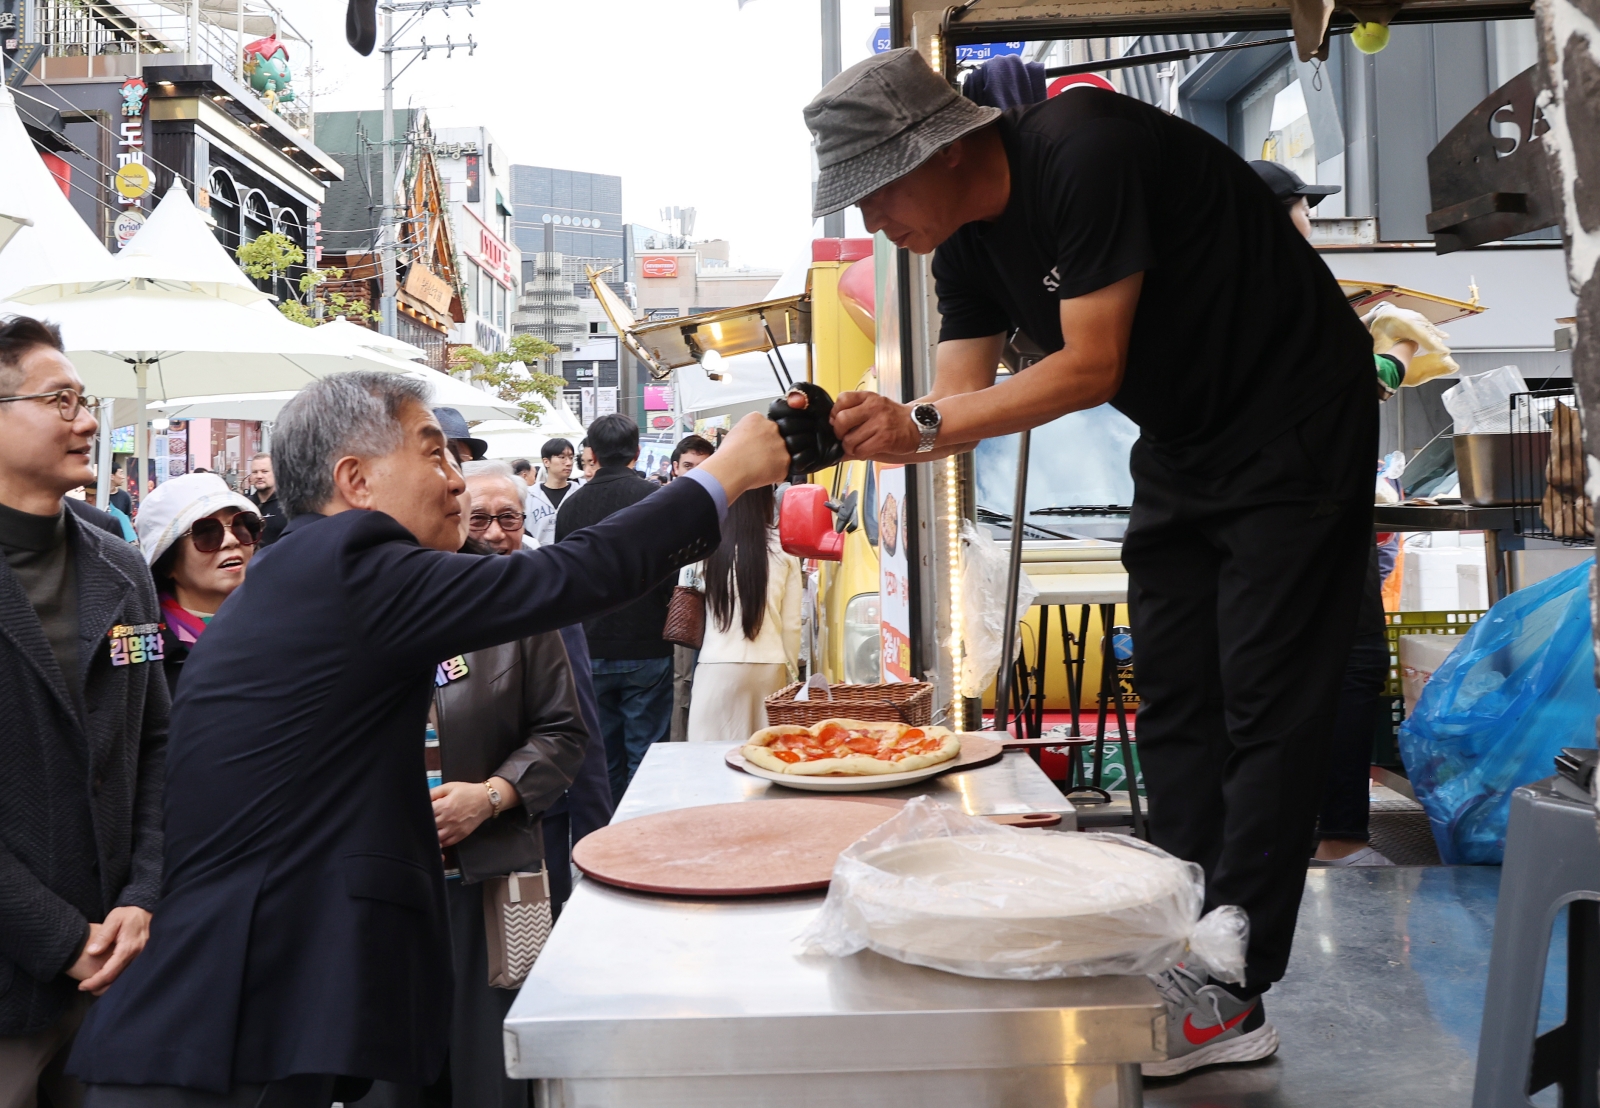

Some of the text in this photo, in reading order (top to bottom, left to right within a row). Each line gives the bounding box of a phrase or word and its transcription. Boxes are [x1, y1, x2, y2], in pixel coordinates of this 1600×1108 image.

[956, 47, 991, 59] 172-gil
[434, 141, 478, 160] 전당포
[110, 633, 165, 666] 김명찬
